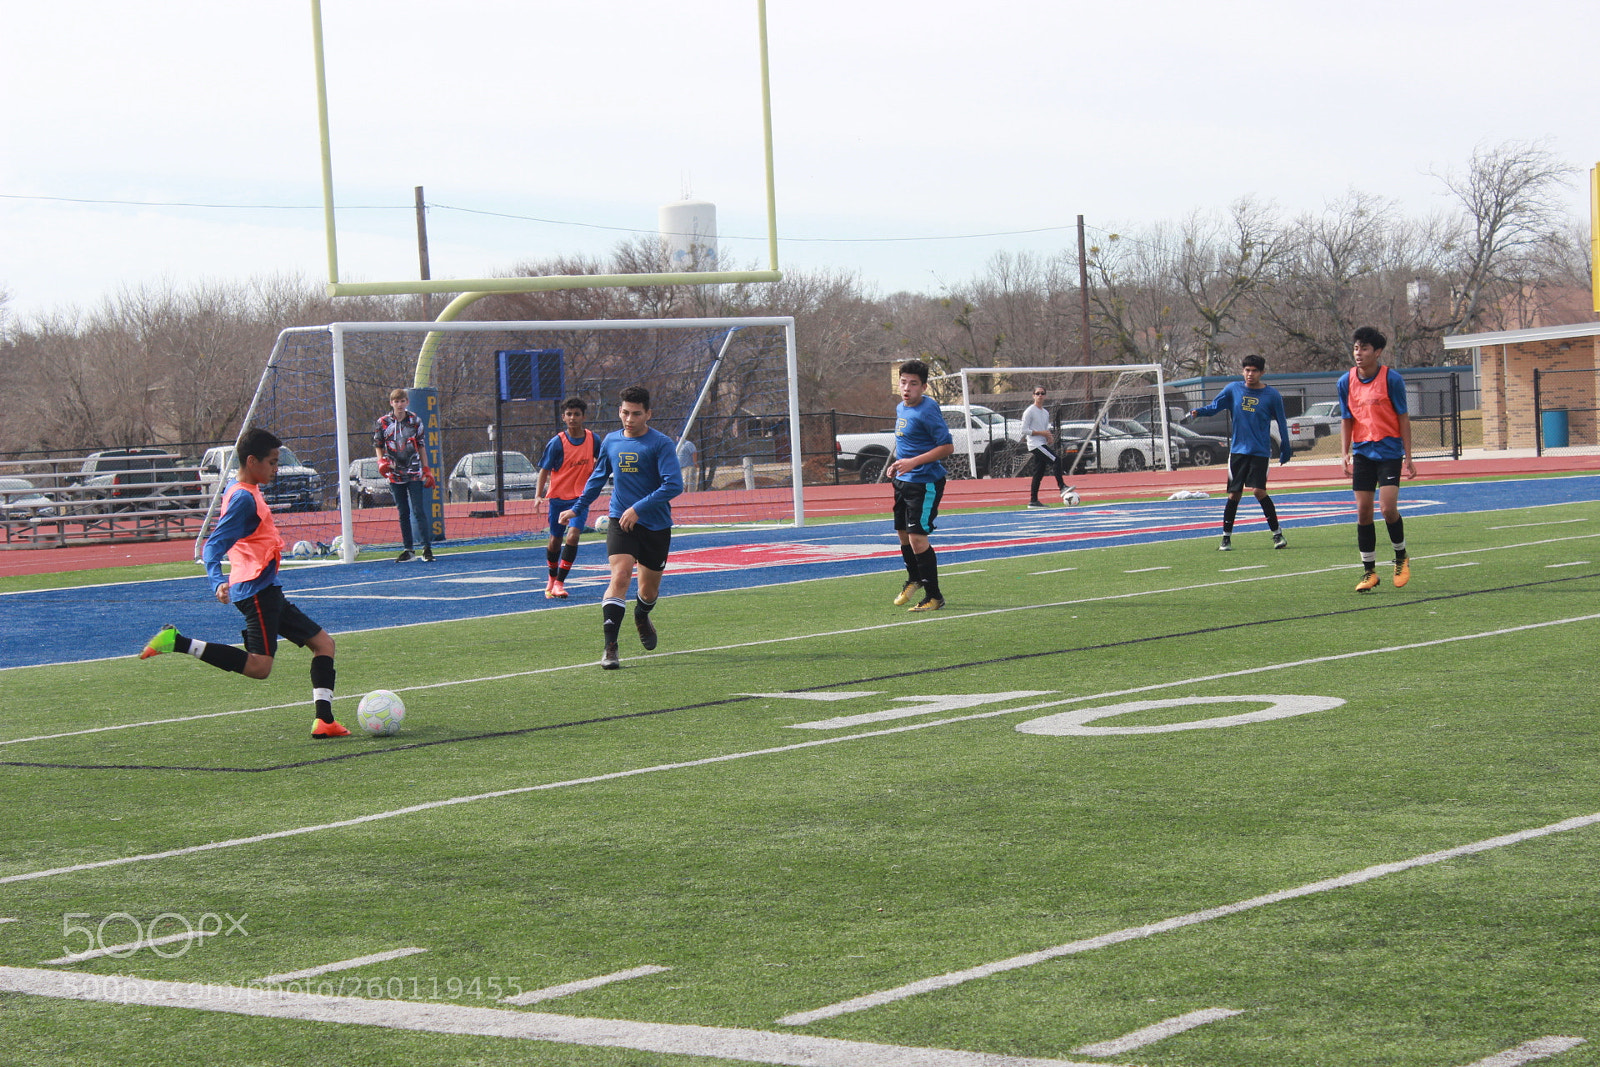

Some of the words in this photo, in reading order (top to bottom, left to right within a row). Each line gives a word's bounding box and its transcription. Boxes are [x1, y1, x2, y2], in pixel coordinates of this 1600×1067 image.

[1242, 396, 1259, 408] P
[427, 396, 442, 535] PANTHERS
[619, 452, 639, 467] P
